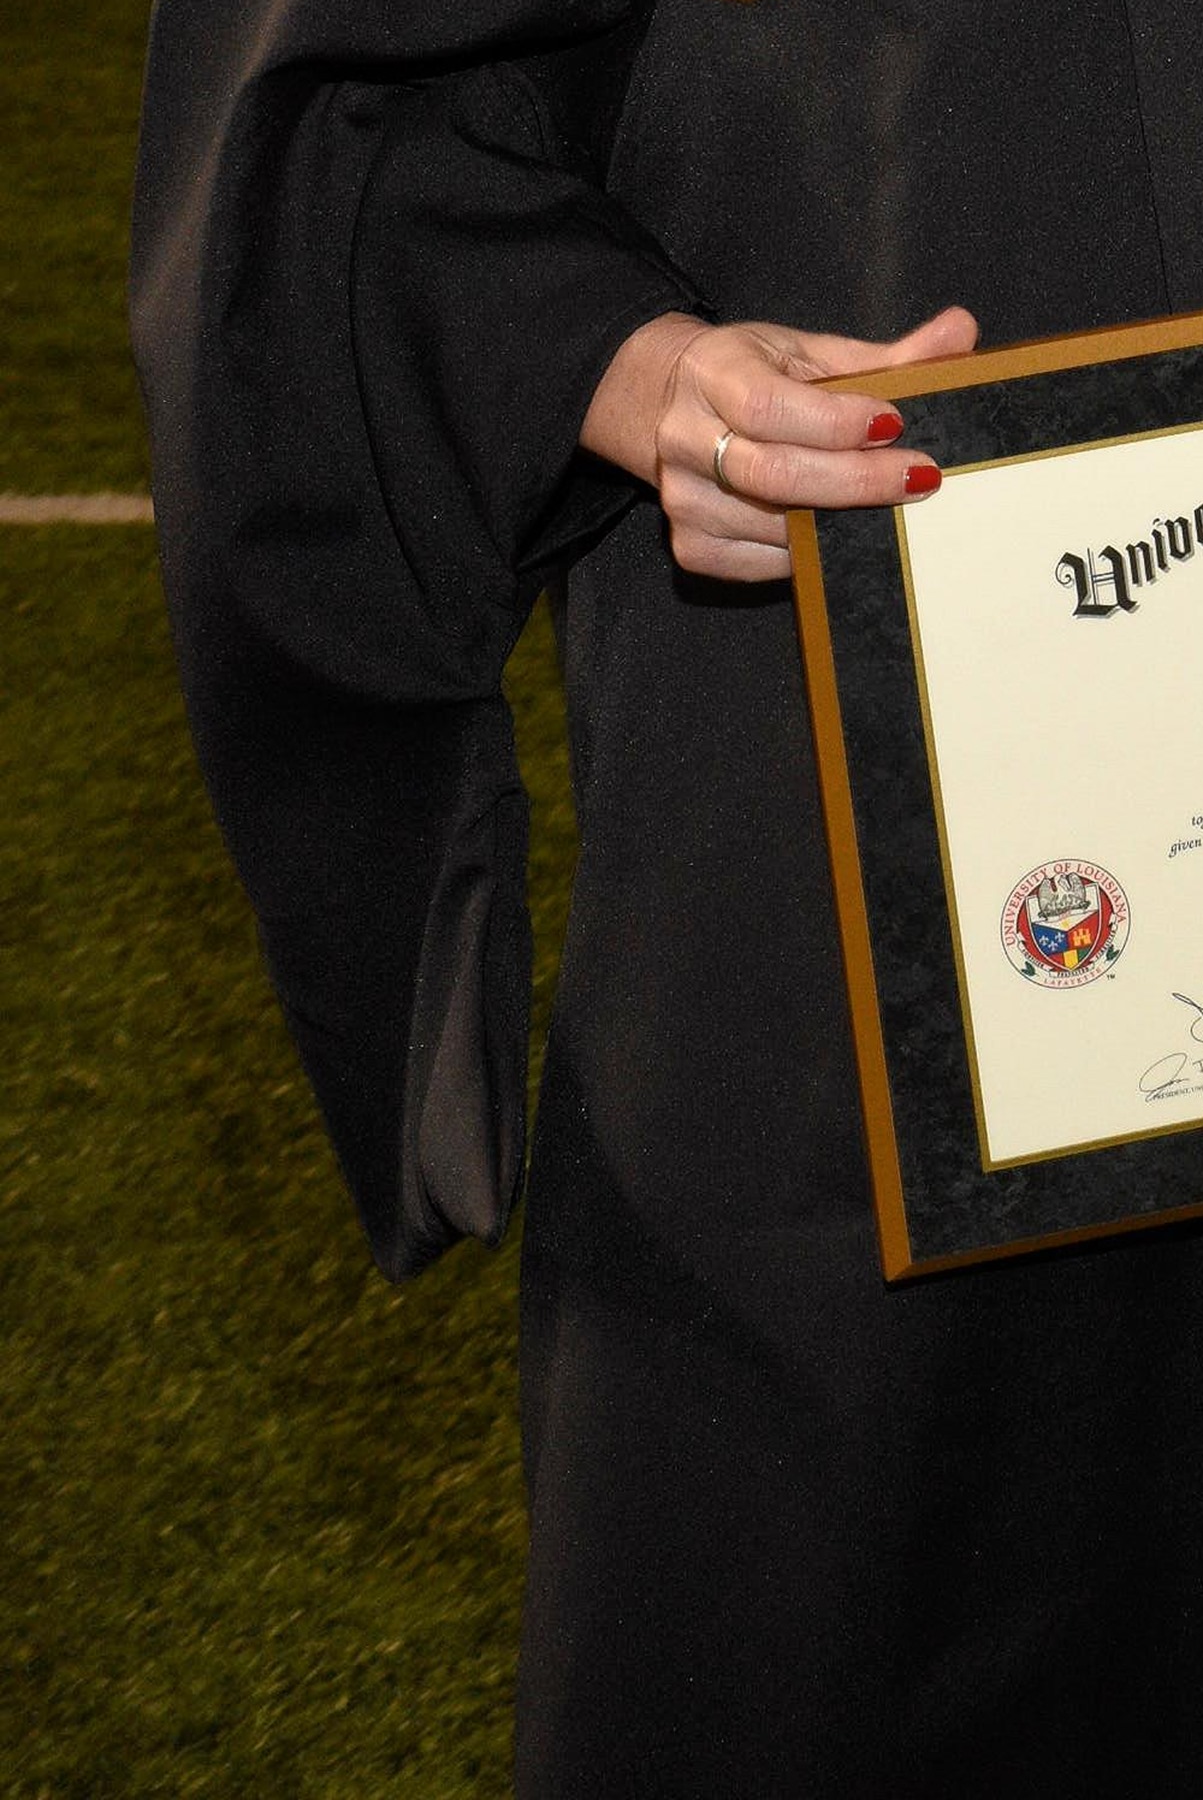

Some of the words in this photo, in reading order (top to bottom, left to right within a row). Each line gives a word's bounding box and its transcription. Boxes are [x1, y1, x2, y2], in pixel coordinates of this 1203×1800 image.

[1169, 839, 1202, 858] given
[1005, 868, 1047, 945] UNIVERSITY
[1053, 863, 1072, 873] OF
[1077, 864, 1126, 922] LOUISIANA
